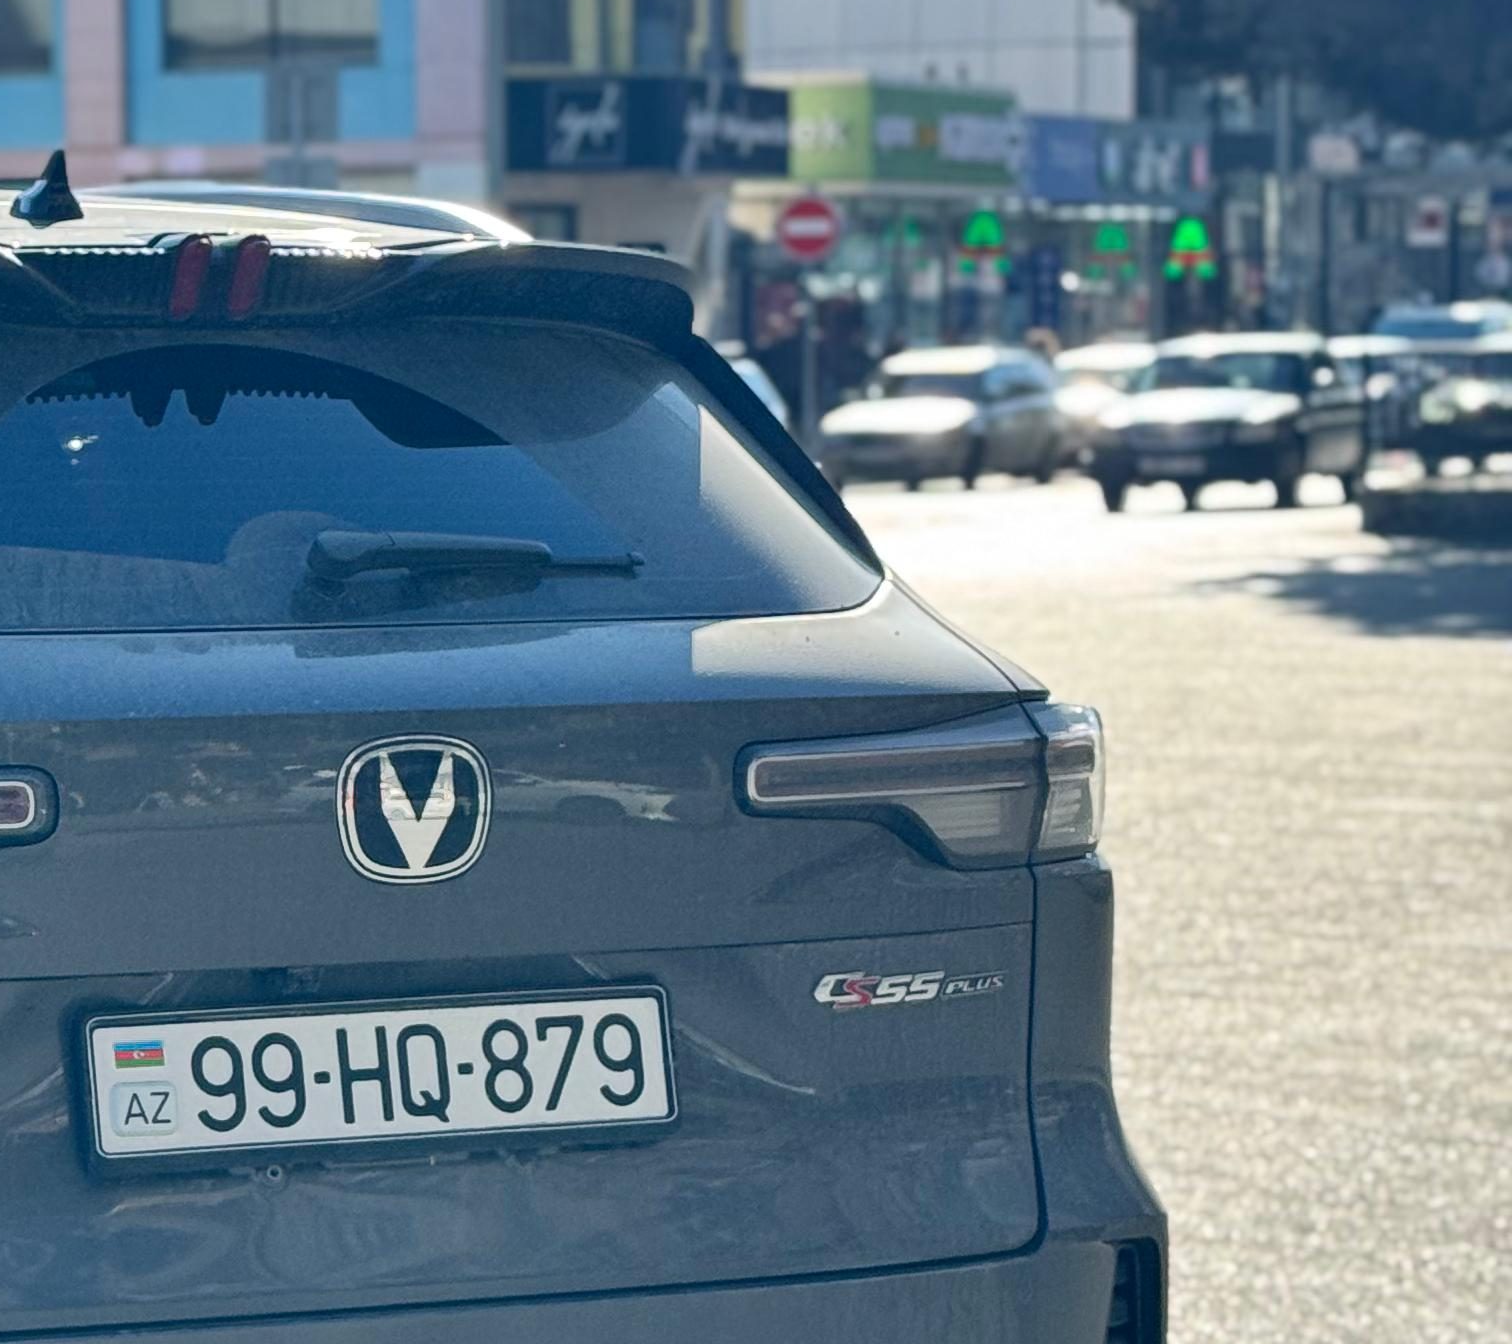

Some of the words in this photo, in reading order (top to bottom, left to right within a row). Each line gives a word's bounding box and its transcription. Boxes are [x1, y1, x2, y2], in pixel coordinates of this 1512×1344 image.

[813, 970, 945, 1009] CS55
[945, 975, 1005, 995] PLUS
[123, 1091, 172, 1126] AZ
